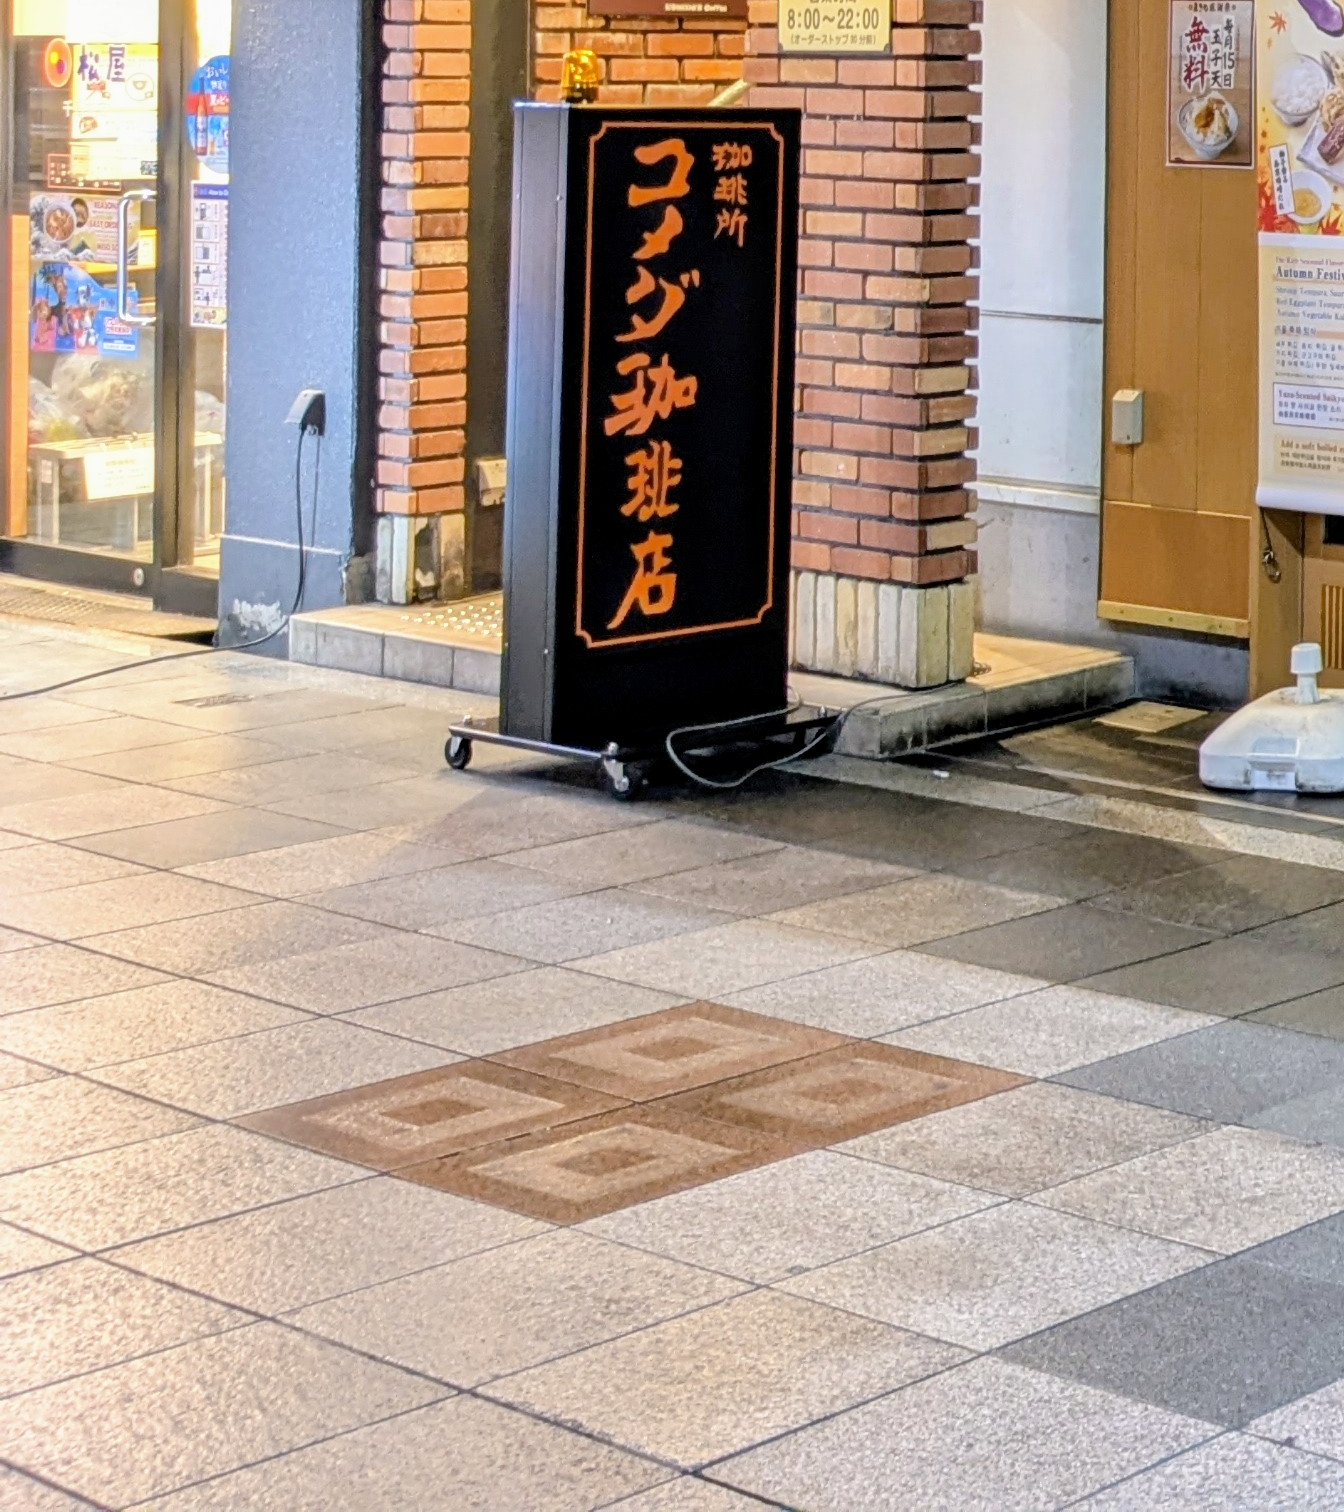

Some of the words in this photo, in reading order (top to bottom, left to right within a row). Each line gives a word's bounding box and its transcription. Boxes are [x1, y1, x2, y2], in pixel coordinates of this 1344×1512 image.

[77, 44, 126, 82] 松屋
[1183, 16, 1210, 89] 無料
[710, 137, 754, 250] 珈琲所
[1276, 266, 1313, 279] Autumn
[604, 136, 701, 632] コメダ珈琲店
